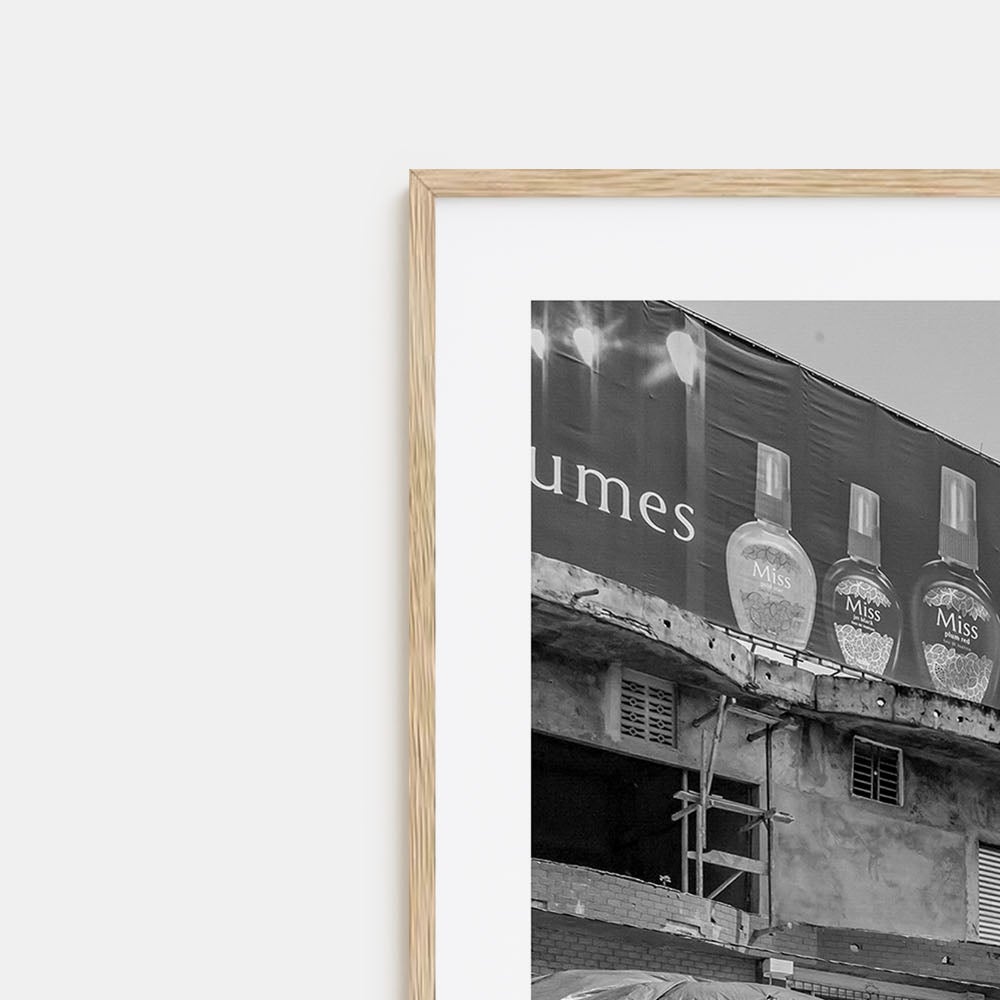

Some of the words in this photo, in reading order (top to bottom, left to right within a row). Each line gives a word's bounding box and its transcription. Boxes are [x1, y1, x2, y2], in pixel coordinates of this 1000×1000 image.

[531, 446, 695, 541] umes
[752, 561, 791, 589] Miss
[846, 595, 880, 622] Miss
[936, 607, 978, 639] Miss
